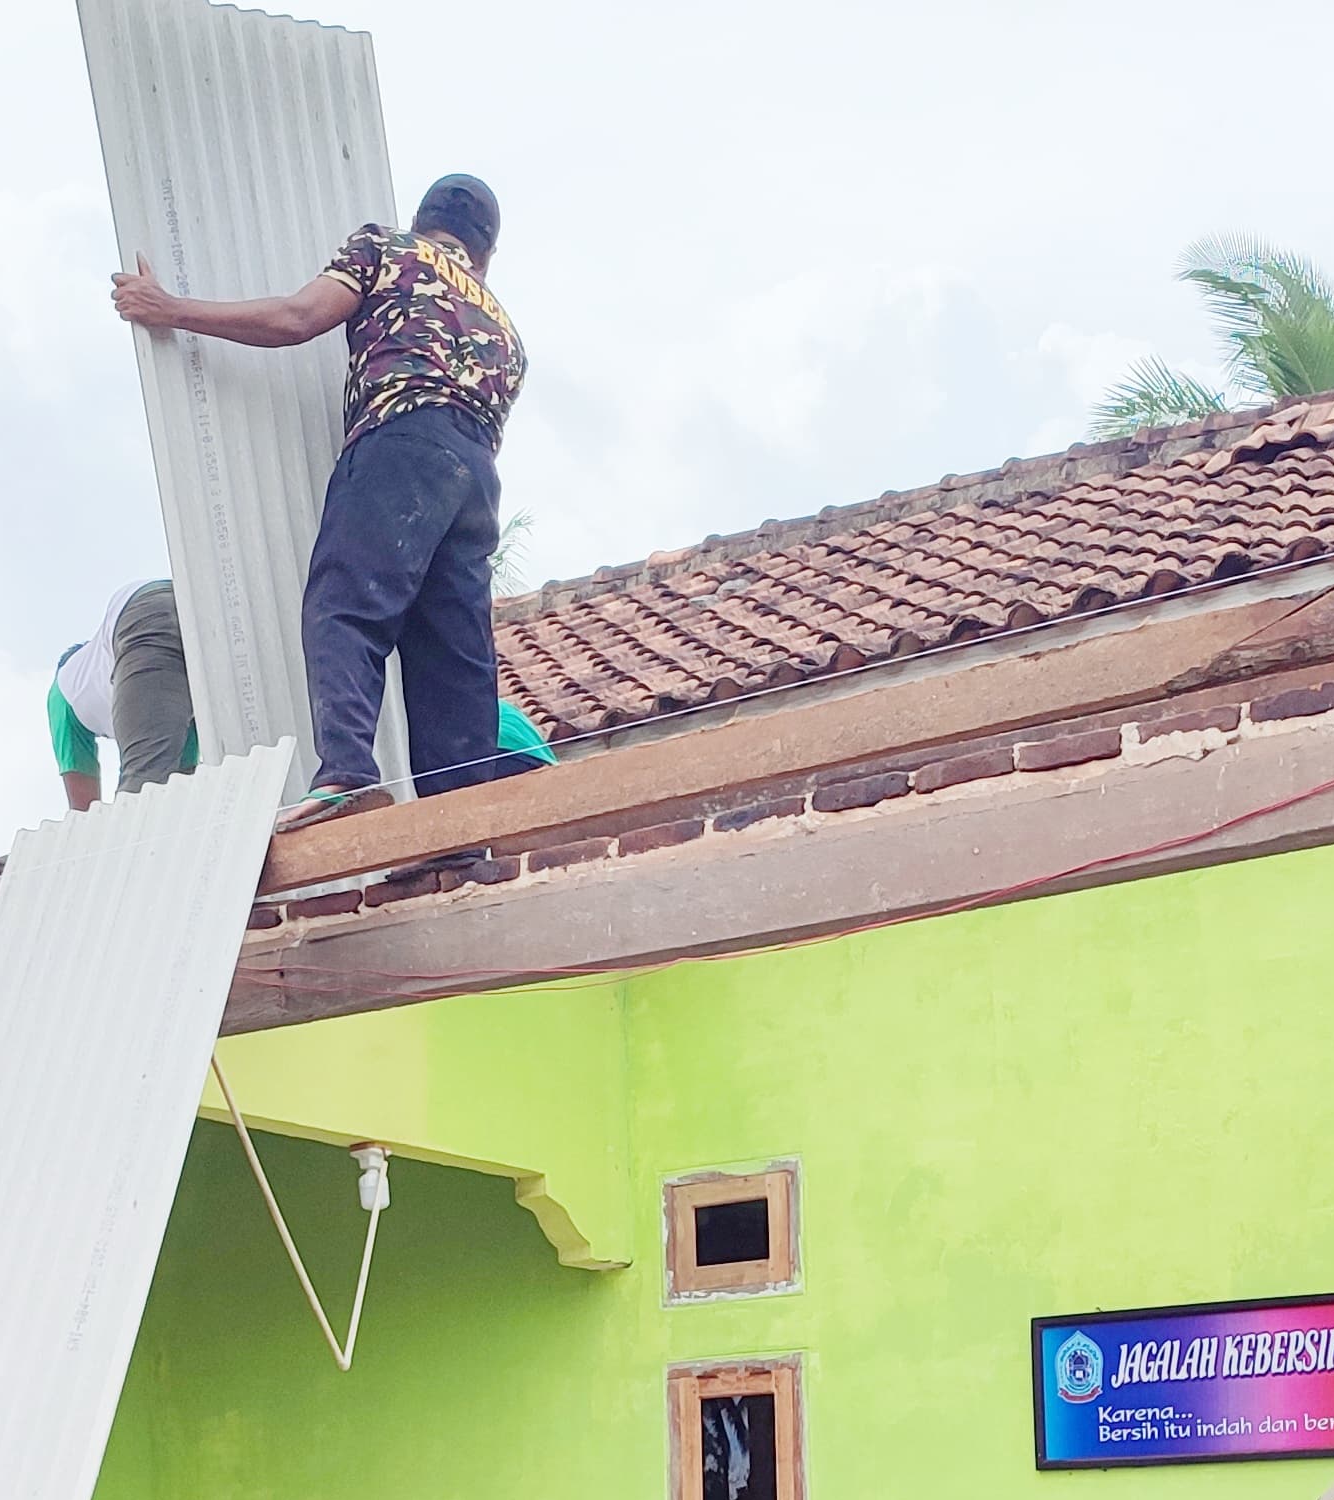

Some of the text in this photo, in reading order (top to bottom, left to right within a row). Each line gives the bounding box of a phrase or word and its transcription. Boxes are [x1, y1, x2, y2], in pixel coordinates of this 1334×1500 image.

[1111, 1336, 1218, 1389] JAGALAH
[1098, 1405, 1193, 1424] Karena...
[1099, 1423, 1159, 1443] Bersih
[1164, 1420, 1191, 1440] itu
[1196, 1416, 1252, 1436] indah
[1258, 1414, 1297, 1435] dan
